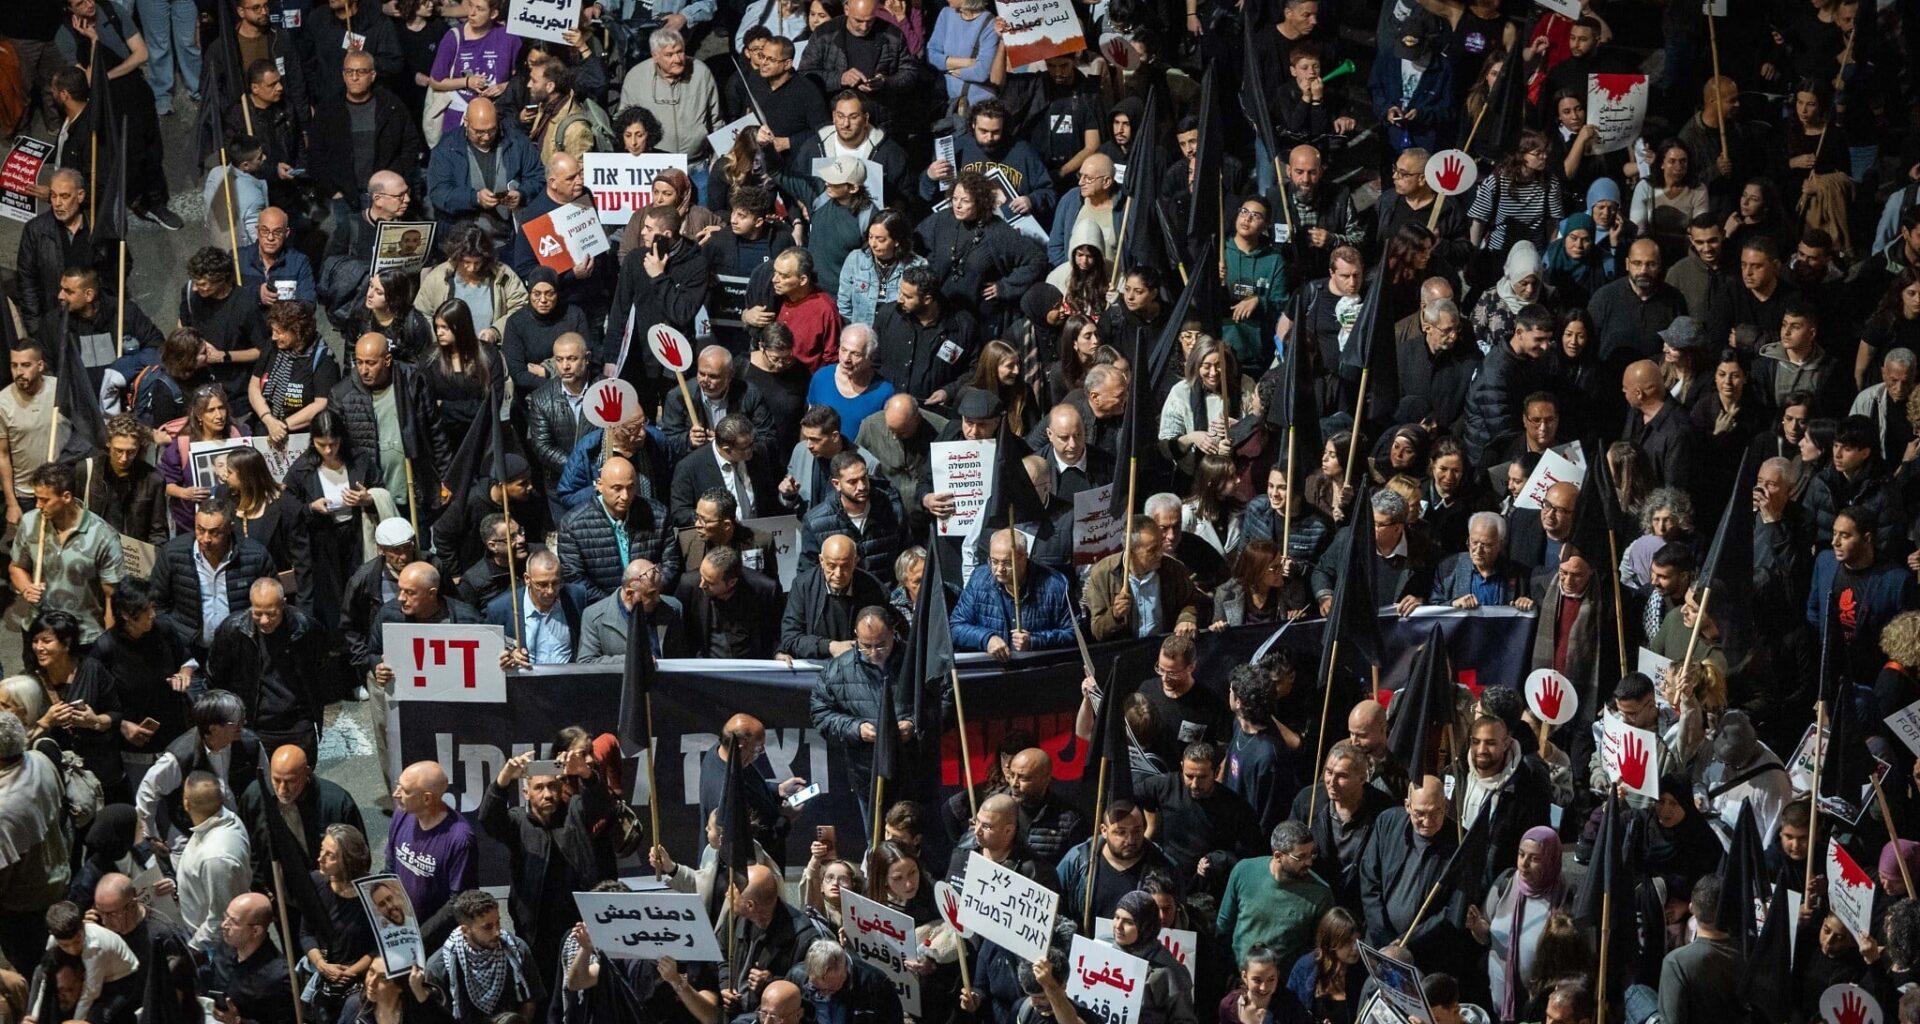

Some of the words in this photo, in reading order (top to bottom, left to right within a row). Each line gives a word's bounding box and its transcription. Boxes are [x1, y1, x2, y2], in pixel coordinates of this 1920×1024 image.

[593, 168, 618, 185] את
[948, 461, 981, 470] הממשלה
[948, 481, 983, 489] והמשטרה
[413, 638, 479, 688] די!
[1896, 717, 1919, 741] FOR
[992, 870, 1012, 888] לא
[1021, 888, 1052, 910] זאת
[595, 904, 641, 924] مش
[644, 906, 697, 922] دمنا
[964, 894, 1013, 929] המטרה
[1016, 924, 1048, 950] זאת
